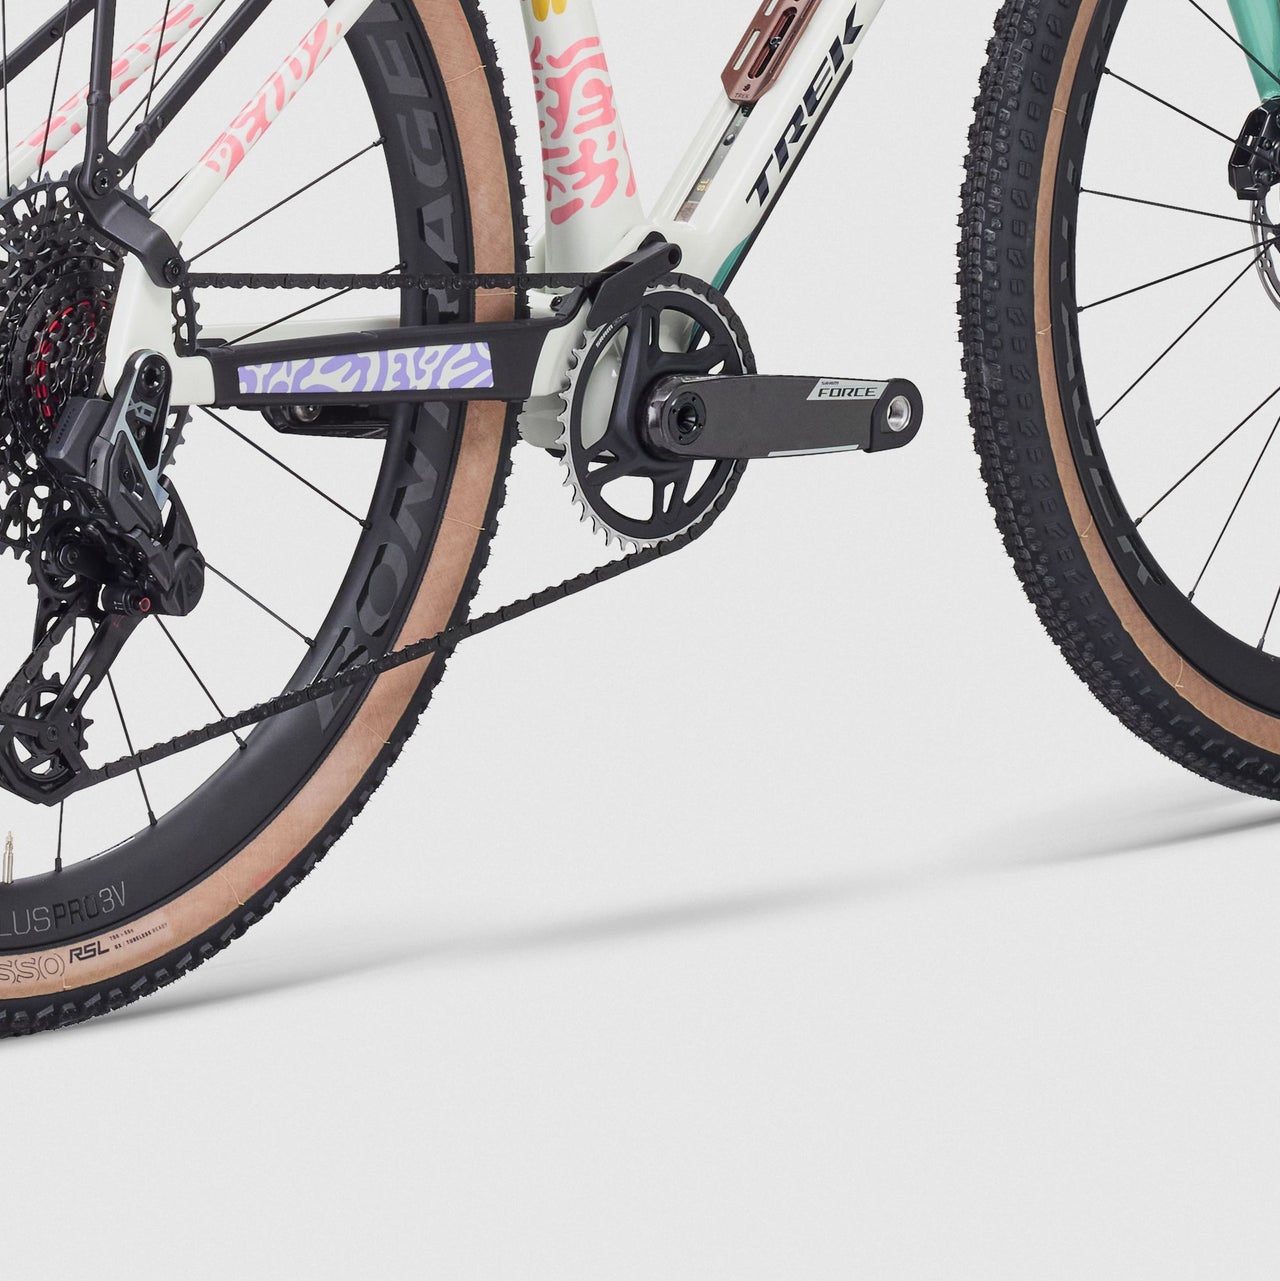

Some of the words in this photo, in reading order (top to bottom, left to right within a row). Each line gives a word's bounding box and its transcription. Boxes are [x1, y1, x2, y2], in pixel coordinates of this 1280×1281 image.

[746, 2, 864, 208] TREK
[818, 387, 878, 397] FORCE
[69, 940, 110, 963] RSL
